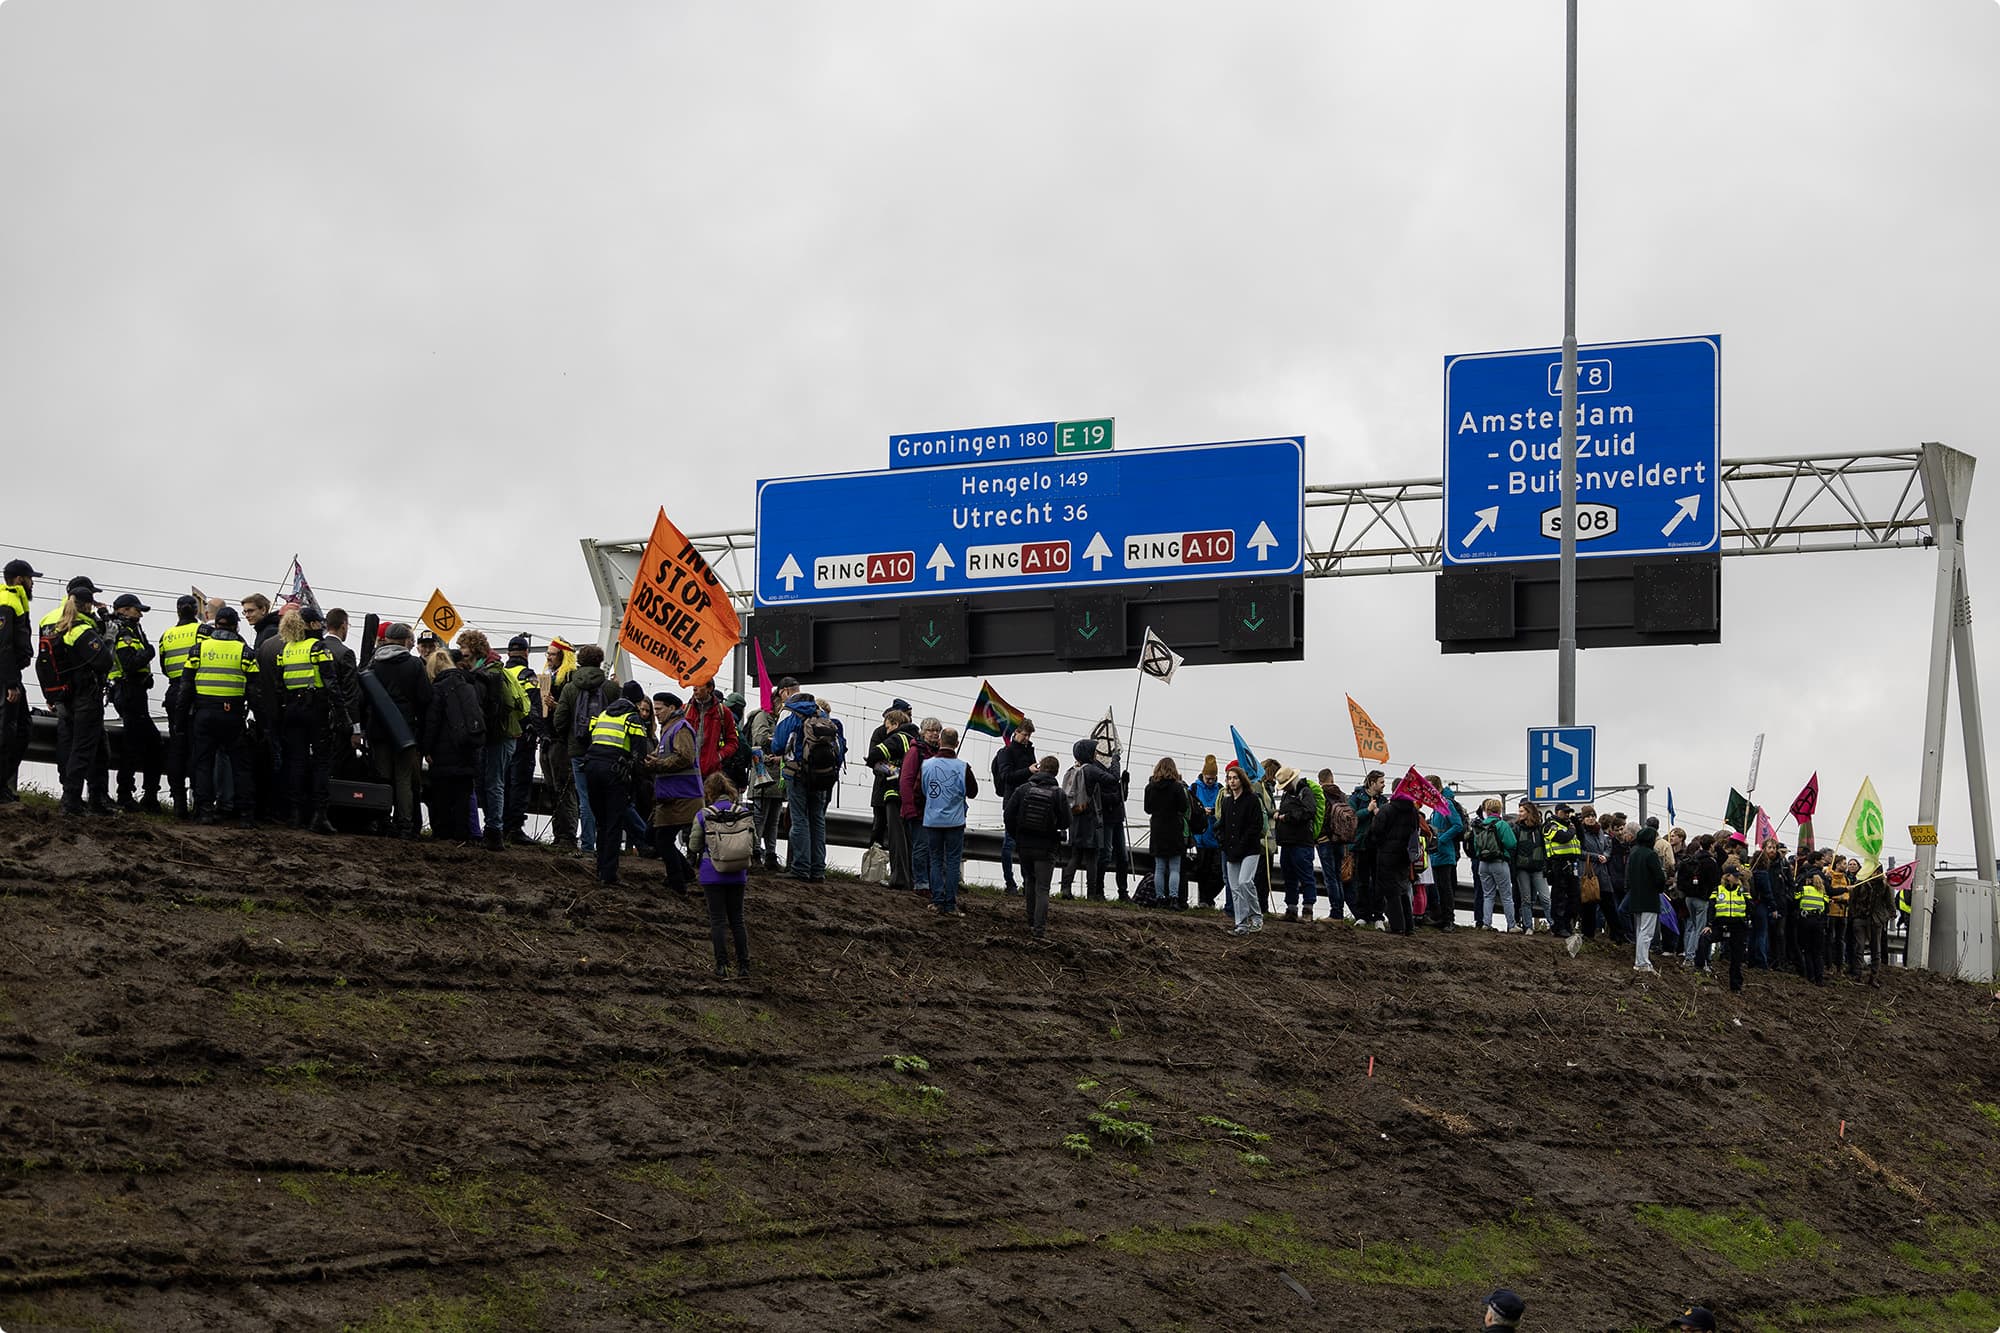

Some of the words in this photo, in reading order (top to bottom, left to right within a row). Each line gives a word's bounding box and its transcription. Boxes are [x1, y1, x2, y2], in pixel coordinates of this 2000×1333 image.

[1588, 367, 1602, 385] 8
[897, 433, 1010, 458] Groningen
[1019, 431, 1048, 447] 180
[1062, 428, 1075, 446] E
[1083, 425, 1105, 445] 19
[962, 473, 1052, 498] Hengelo
[1059, 471, 1088, 488] 149
[953, 502, 1053, 529] Utrecht
[1063, 504, 1088, 521] 36
[1550, 511, 1609, 531] s08
[969, 551, 1019, 571] RING
[1024, 546, 1067, 569] A10
[1128, 541, 1180, 561] RING
[1186, 536, 1230, 558] A10
[817, 562, 865, 581] RING
[870, 556, 910, 579] A10
[655, 559, 712, 613] STOP
